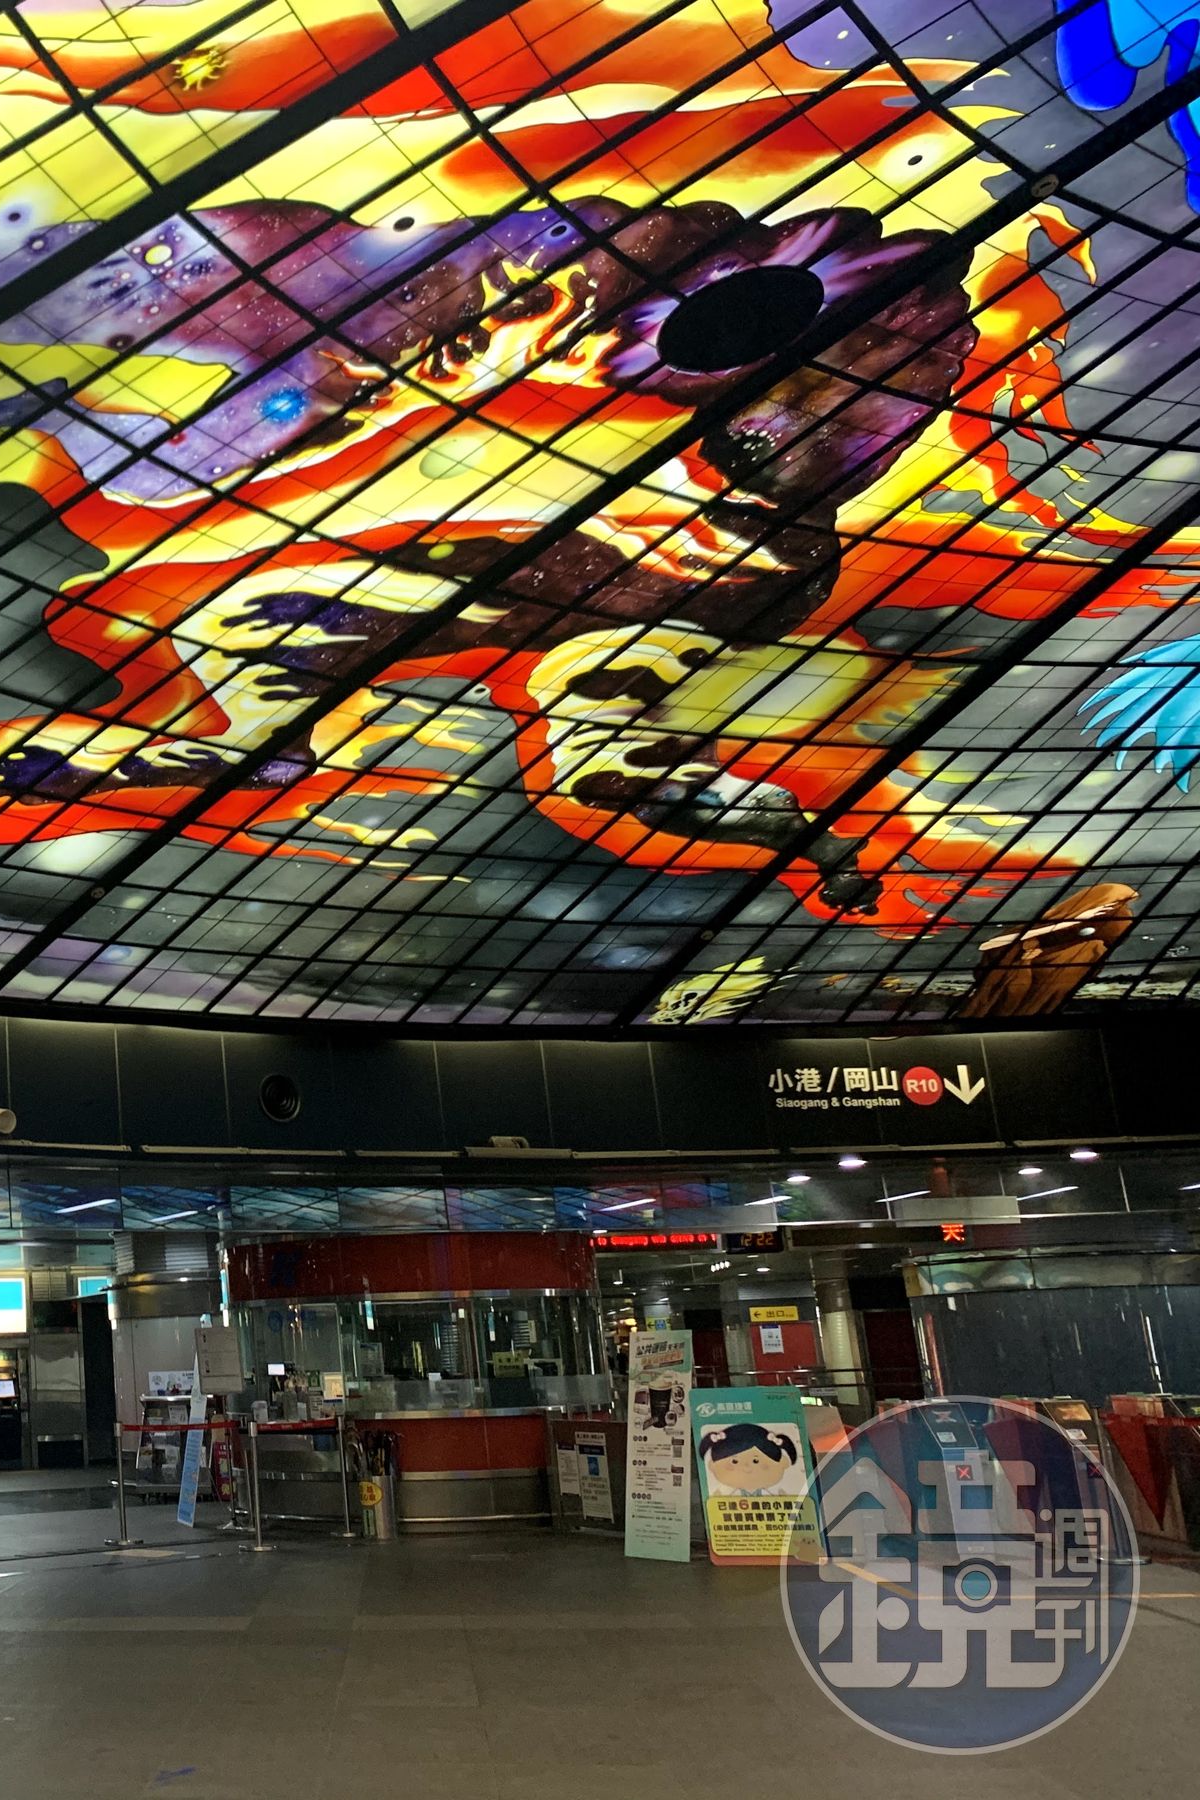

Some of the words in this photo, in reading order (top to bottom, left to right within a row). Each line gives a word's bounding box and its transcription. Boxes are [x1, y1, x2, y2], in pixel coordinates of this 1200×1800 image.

[768, 1067, 899, 1093] 小港/岡山
[906, 1079, 939, 1093] R10
[776, 1098, 828, 1109] Siaogang
[830, 1098, 840, 1108] &
[842, 1097, 900, 1109] Gangshan
